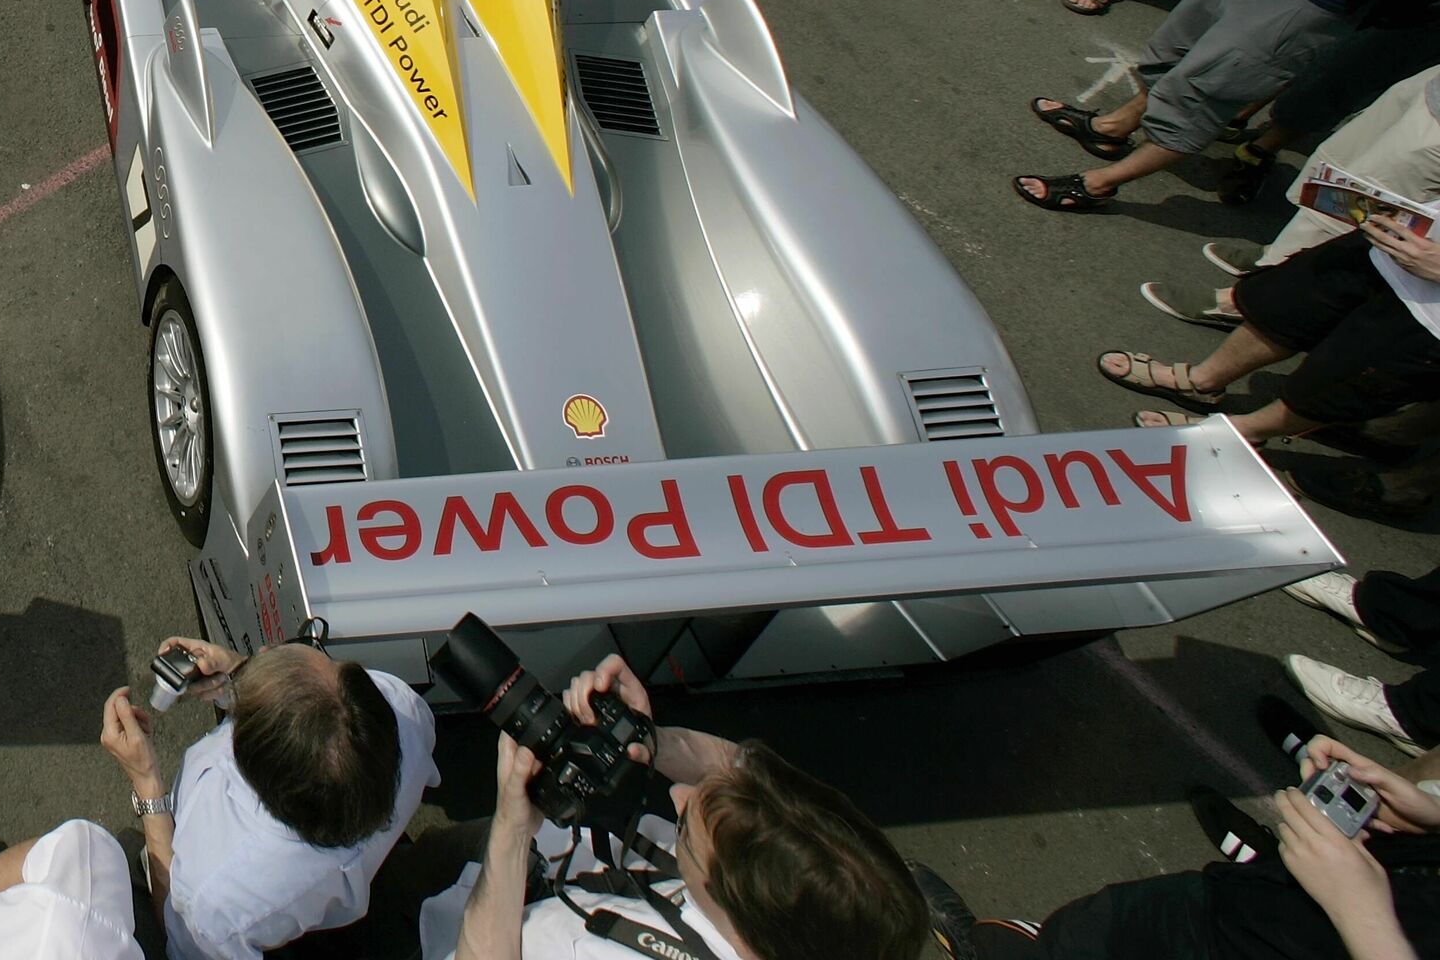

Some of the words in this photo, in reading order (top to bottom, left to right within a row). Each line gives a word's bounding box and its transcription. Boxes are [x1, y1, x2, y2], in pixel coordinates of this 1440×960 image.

[388, 35, 448, 119] Power
[585, 456, 629, 466] BOSCH
[944, 446, 1191, 540] Audi
[312, 480, 701, 566] Power
[728, 460, 931, 553] TDI
[638, 932, 701, 960] Cano
